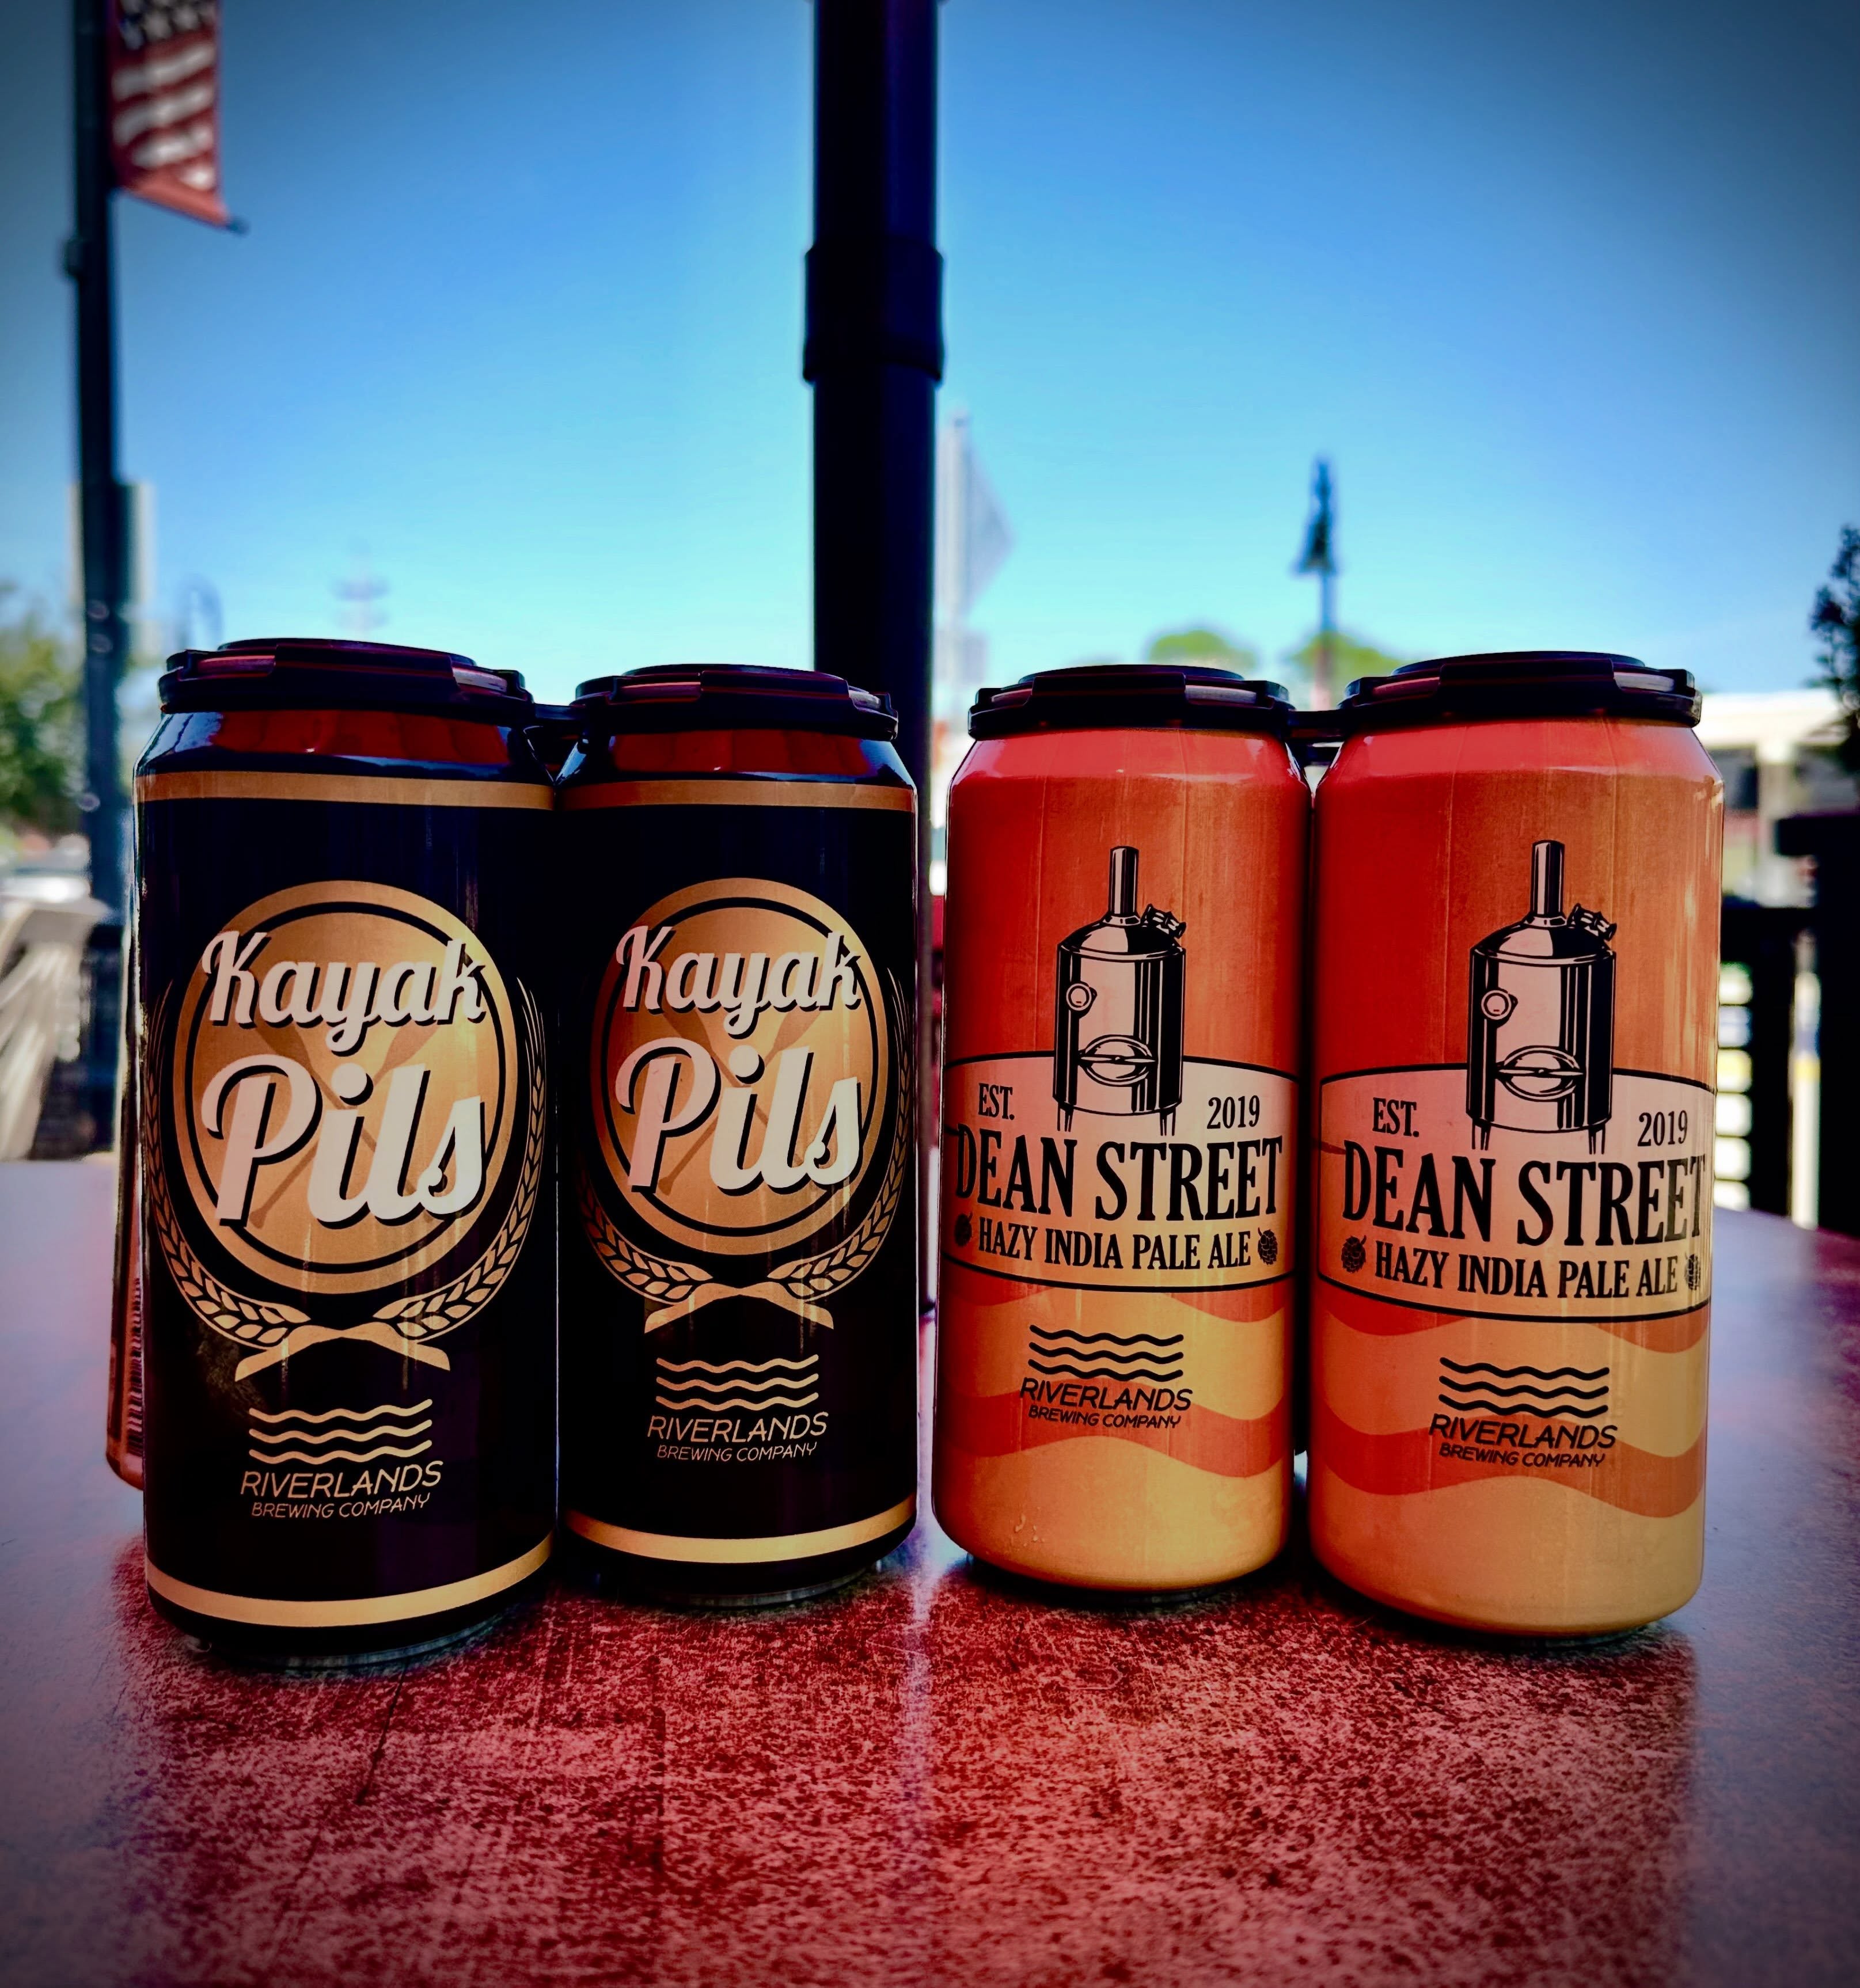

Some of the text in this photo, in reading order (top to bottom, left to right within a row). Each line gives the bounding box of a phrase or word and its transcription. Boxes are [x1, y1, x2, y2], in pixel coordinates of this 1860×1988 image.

[201, 930, 485, 1052] Kayak
[616, 926, 861, 1035] Kayak
[616, 1037, 860, 1192] Pils
[978, 1083, 1015, 1120] EST.
[1208, 1095, 1261, 1129] 2019
[1372, 1097, 1419, 1138] EST.
[202, 1054, 483, 1223] Pils
[1637, 1110, 1688, 1147] 2019
[956, 1124, 1282, 1221] DEAN STREET
[1343, 1140, 1706, 1246] DEAN STREET
[978, 1217, 1251, 1269] HAZY INDIA PALE ALE
[1375, 1241, 1679, 1299] HAZY INDIA PALE ALE
[1019, 1377, 1193, 1411] RIVERLANDS
[648, 1411, 829, 1443] RIVERLANDS
[1029, 1405, 1181, 1428] BREWING COMPANY
[1429, 1413, 1618, 1449] RIVERLANDS
[657, 1442, 817, 1461] BREWING COMPANY
[1439, 1444, 1605, 1468] BREWING COMPANY
[241, 1461, 443, 1498] RIVERLANDS
[252, 1493, 430, 1519] BREWING COMPANY
